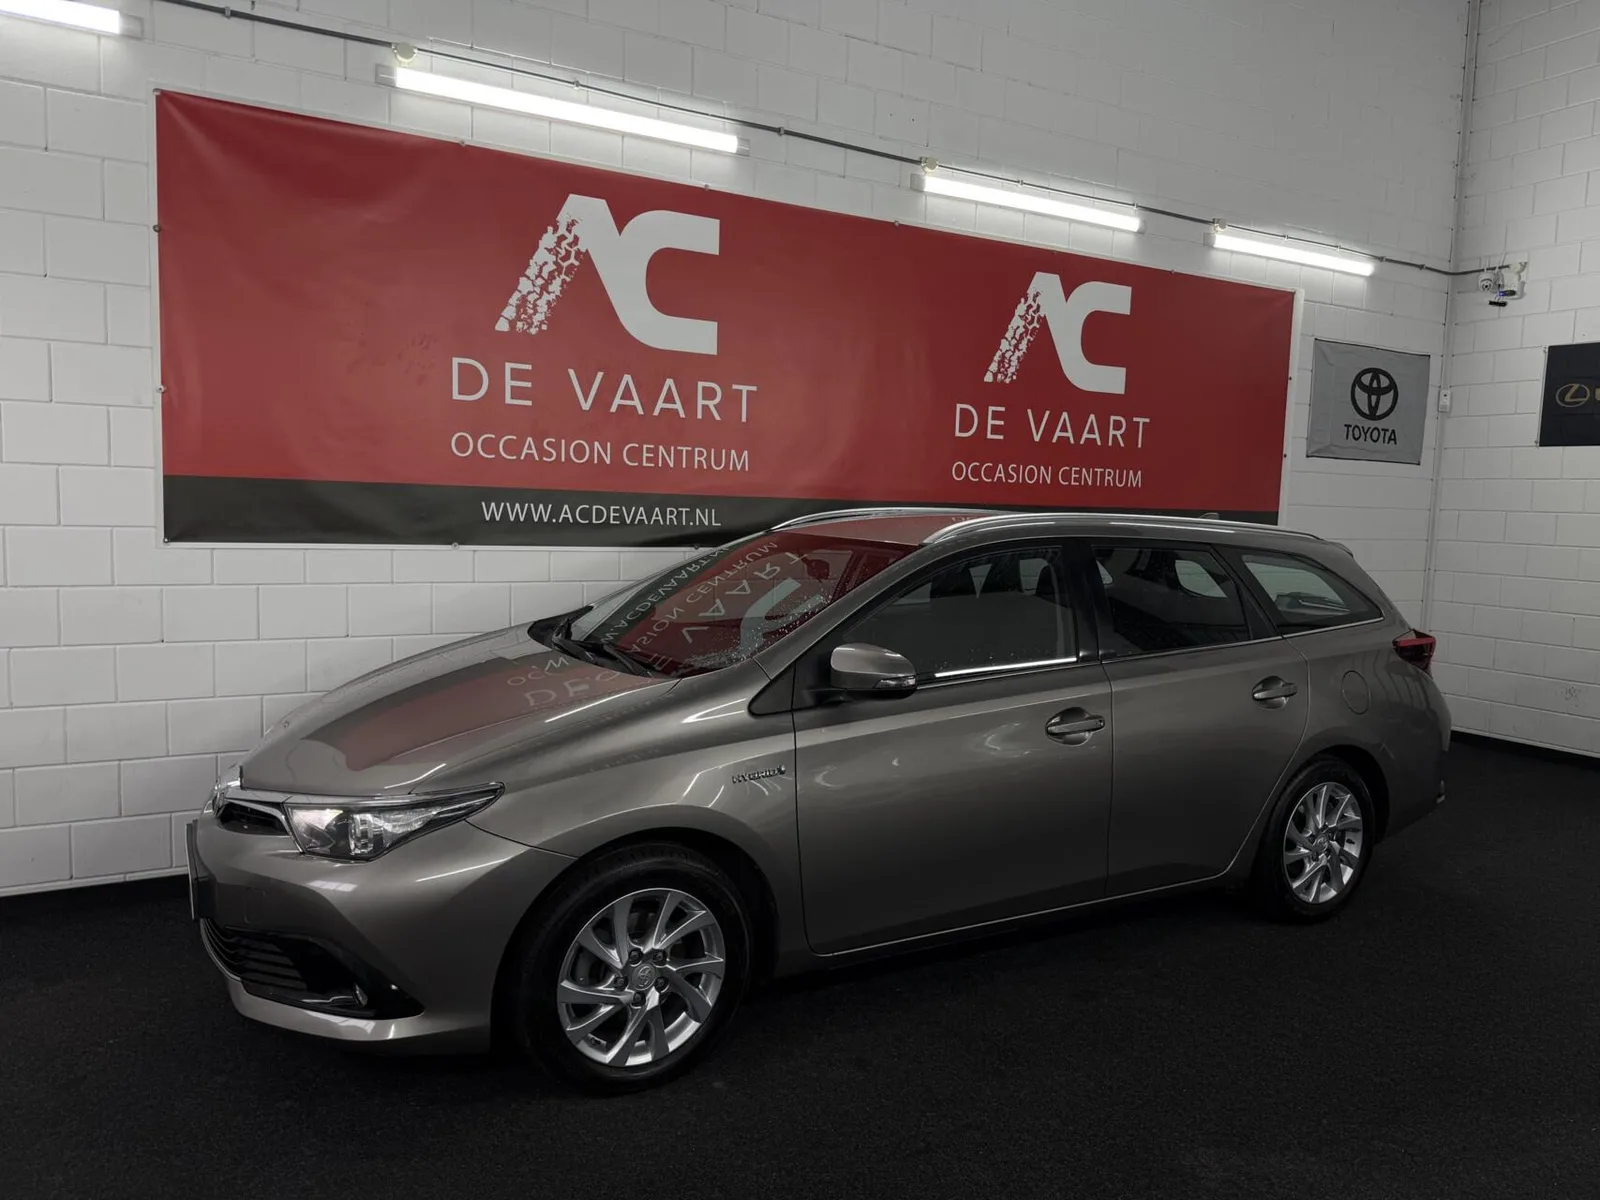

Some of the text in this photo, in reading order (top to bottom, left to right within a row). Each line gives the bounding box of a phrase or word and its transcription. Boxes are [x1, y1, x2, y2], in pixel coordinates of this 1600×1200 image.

[451, 357, 758, 423] DE VAART
[954, 403, 1150, 448] DE VAART
[1343, 424, 1398, 445] TOYOTA
[450, 431, 750, 472] OCCASION CENTRUM
[951, 461, 1142, 488] OCCASION CENTRUM
[481, 501, 722, 527] WWW.ACDEVAART.NL
[731, 766, 779, 784] HYBRID
